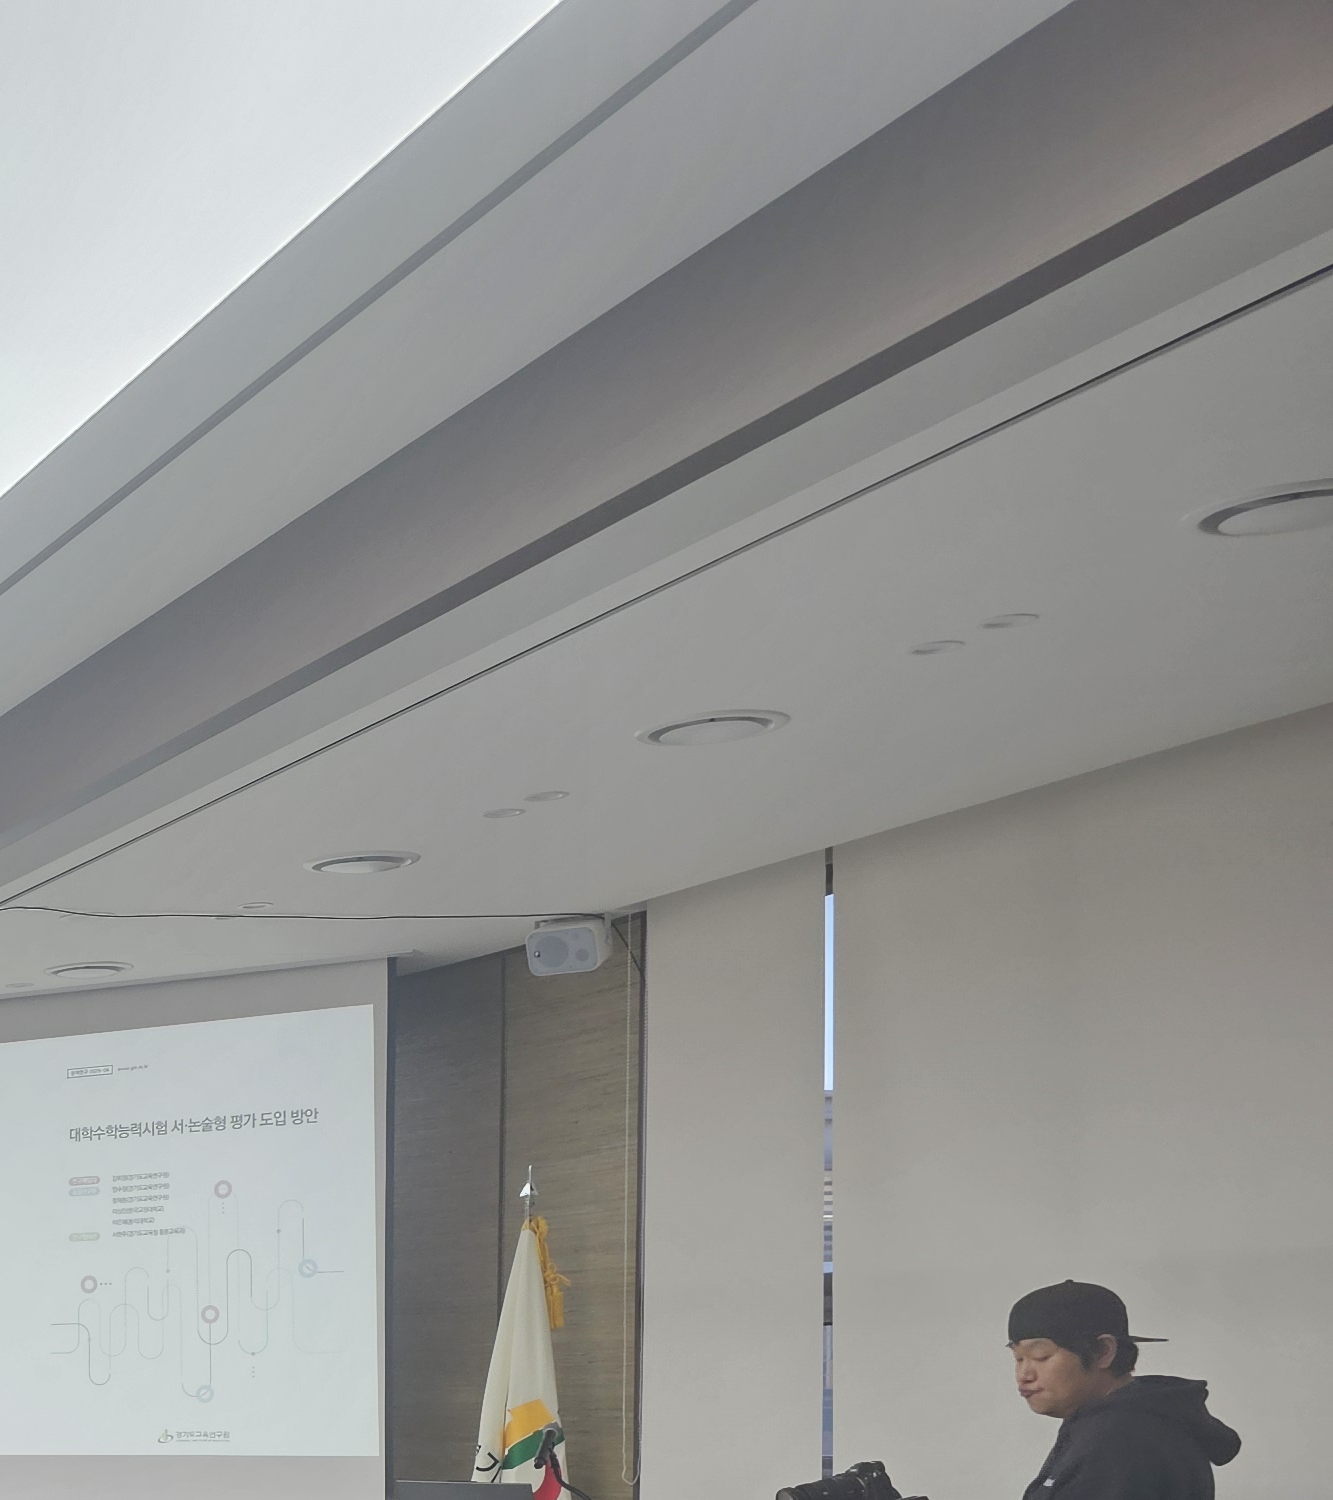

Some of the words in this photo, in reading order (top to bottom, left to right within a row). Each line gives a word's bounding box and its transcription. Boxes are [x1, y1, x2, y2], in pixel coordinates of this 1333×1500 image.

[69, 1119, 168, 1142] 대학수학능력시험
[230, 1113, 257, 1130] 평가
[259, 1110, 286, 1127] 도입
[290, 1107, 319, 1125] 방안
